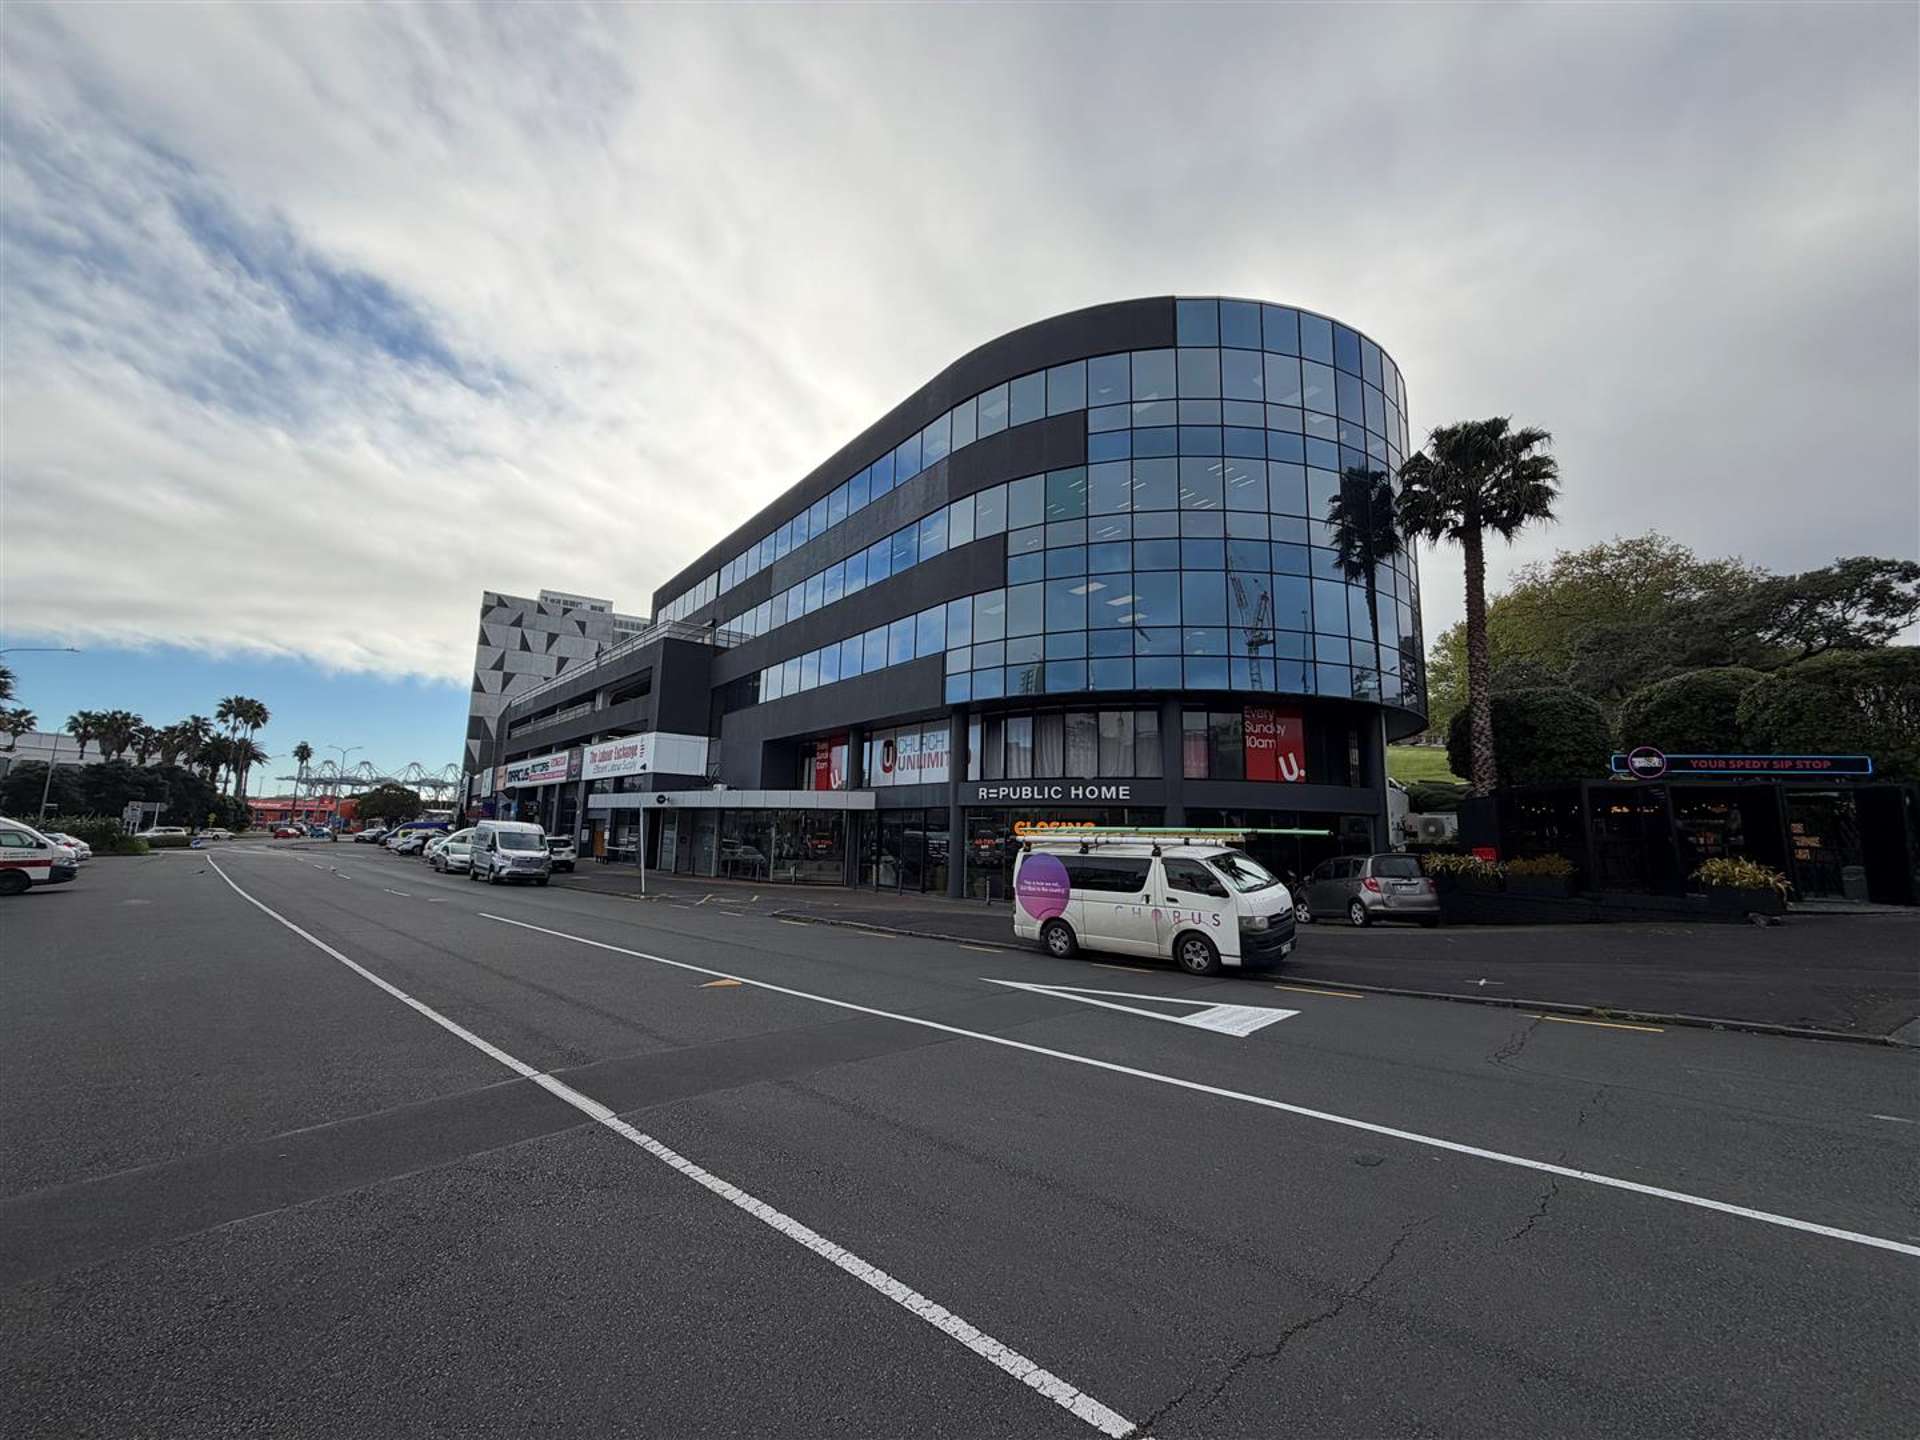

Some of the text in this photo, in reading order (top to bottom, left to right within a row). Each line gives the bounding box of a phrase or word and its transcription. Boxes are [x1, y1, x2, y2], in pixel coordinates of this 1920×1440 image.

[1243, 705, 1275, 720] Every
[898, 733, 945, 754] CHURCH
[1245, 735, 1277, 749] 10am
[1690, 759, 1727, 769] YOUR
[1771, 759, 1793, 769] SIP
[1795, 759, 1832, 769] STOP
[1071, 785, 1131, 800] HOME
[1114, 905, 1222, 927] CHORUS
